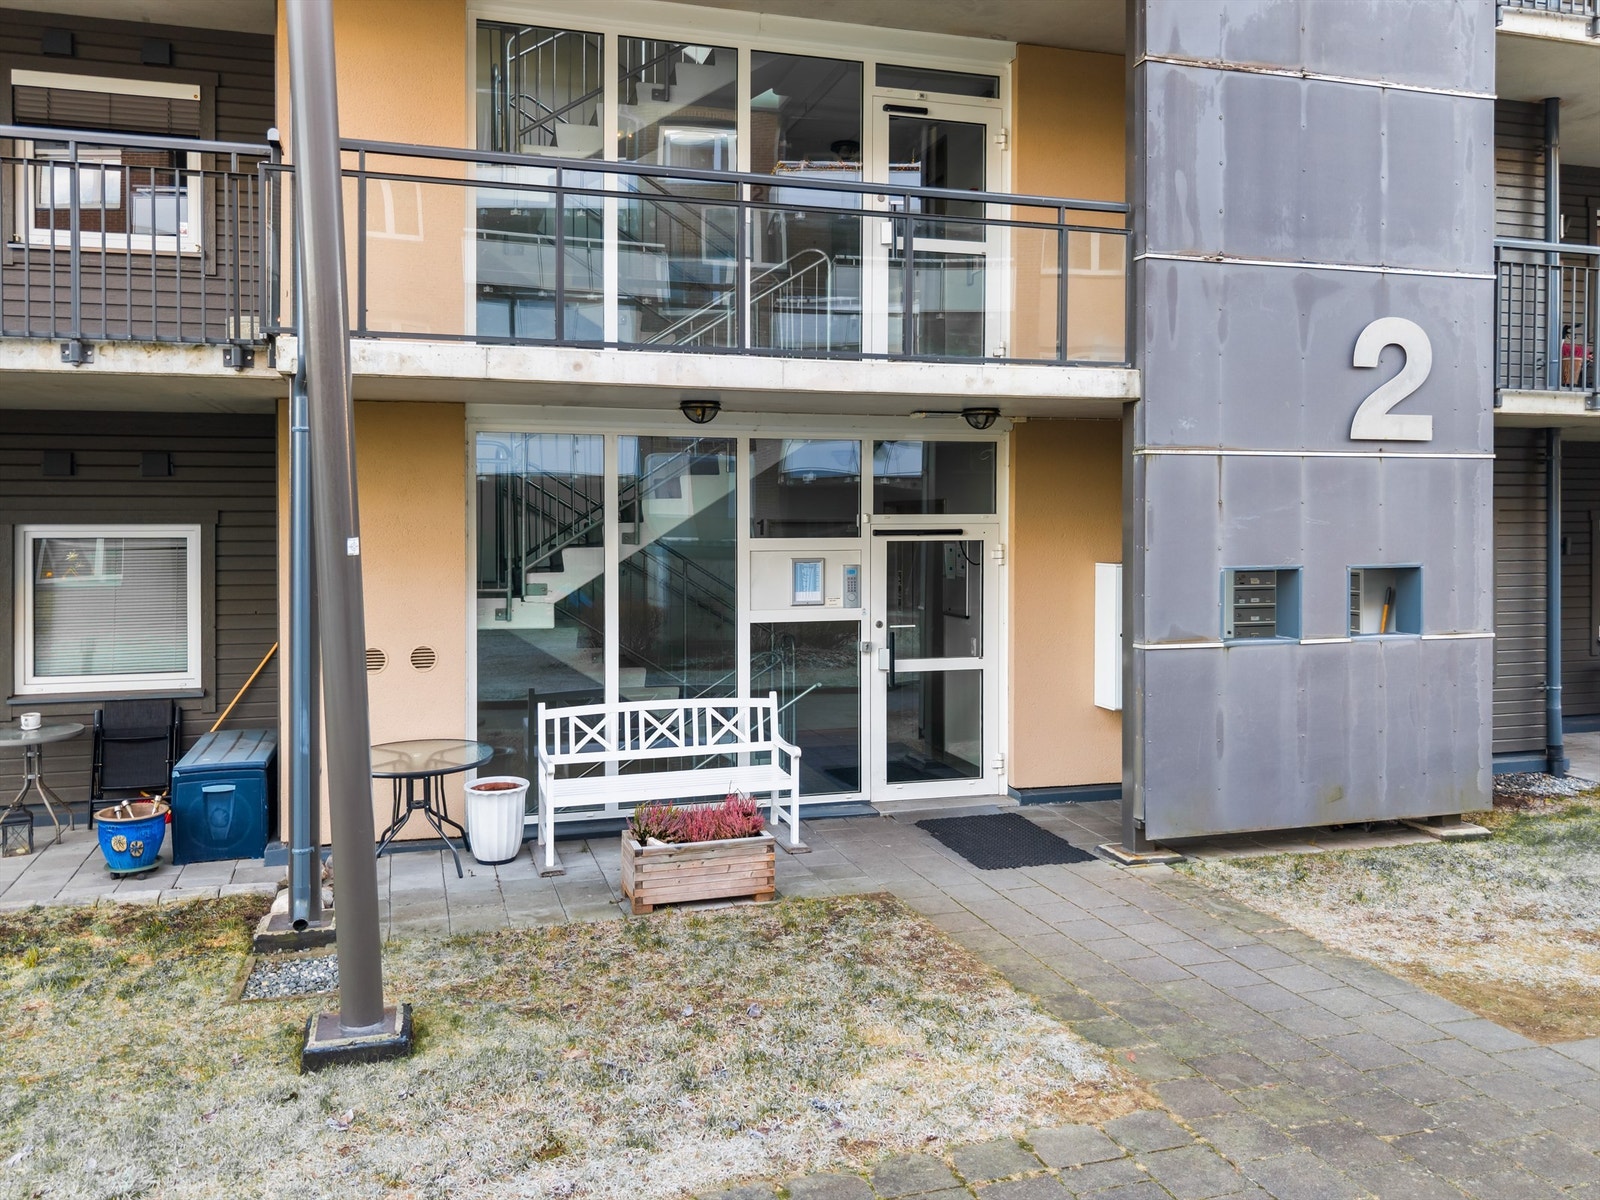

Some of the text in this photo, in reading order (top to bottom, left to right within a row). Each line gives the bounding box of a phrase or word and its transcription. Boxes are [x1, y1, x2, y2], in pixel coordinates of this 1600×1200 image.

[752, 186, 764, 201] 2
[1350, 316, 1433, 441] 2
[756, 519, 765, 536] 1
